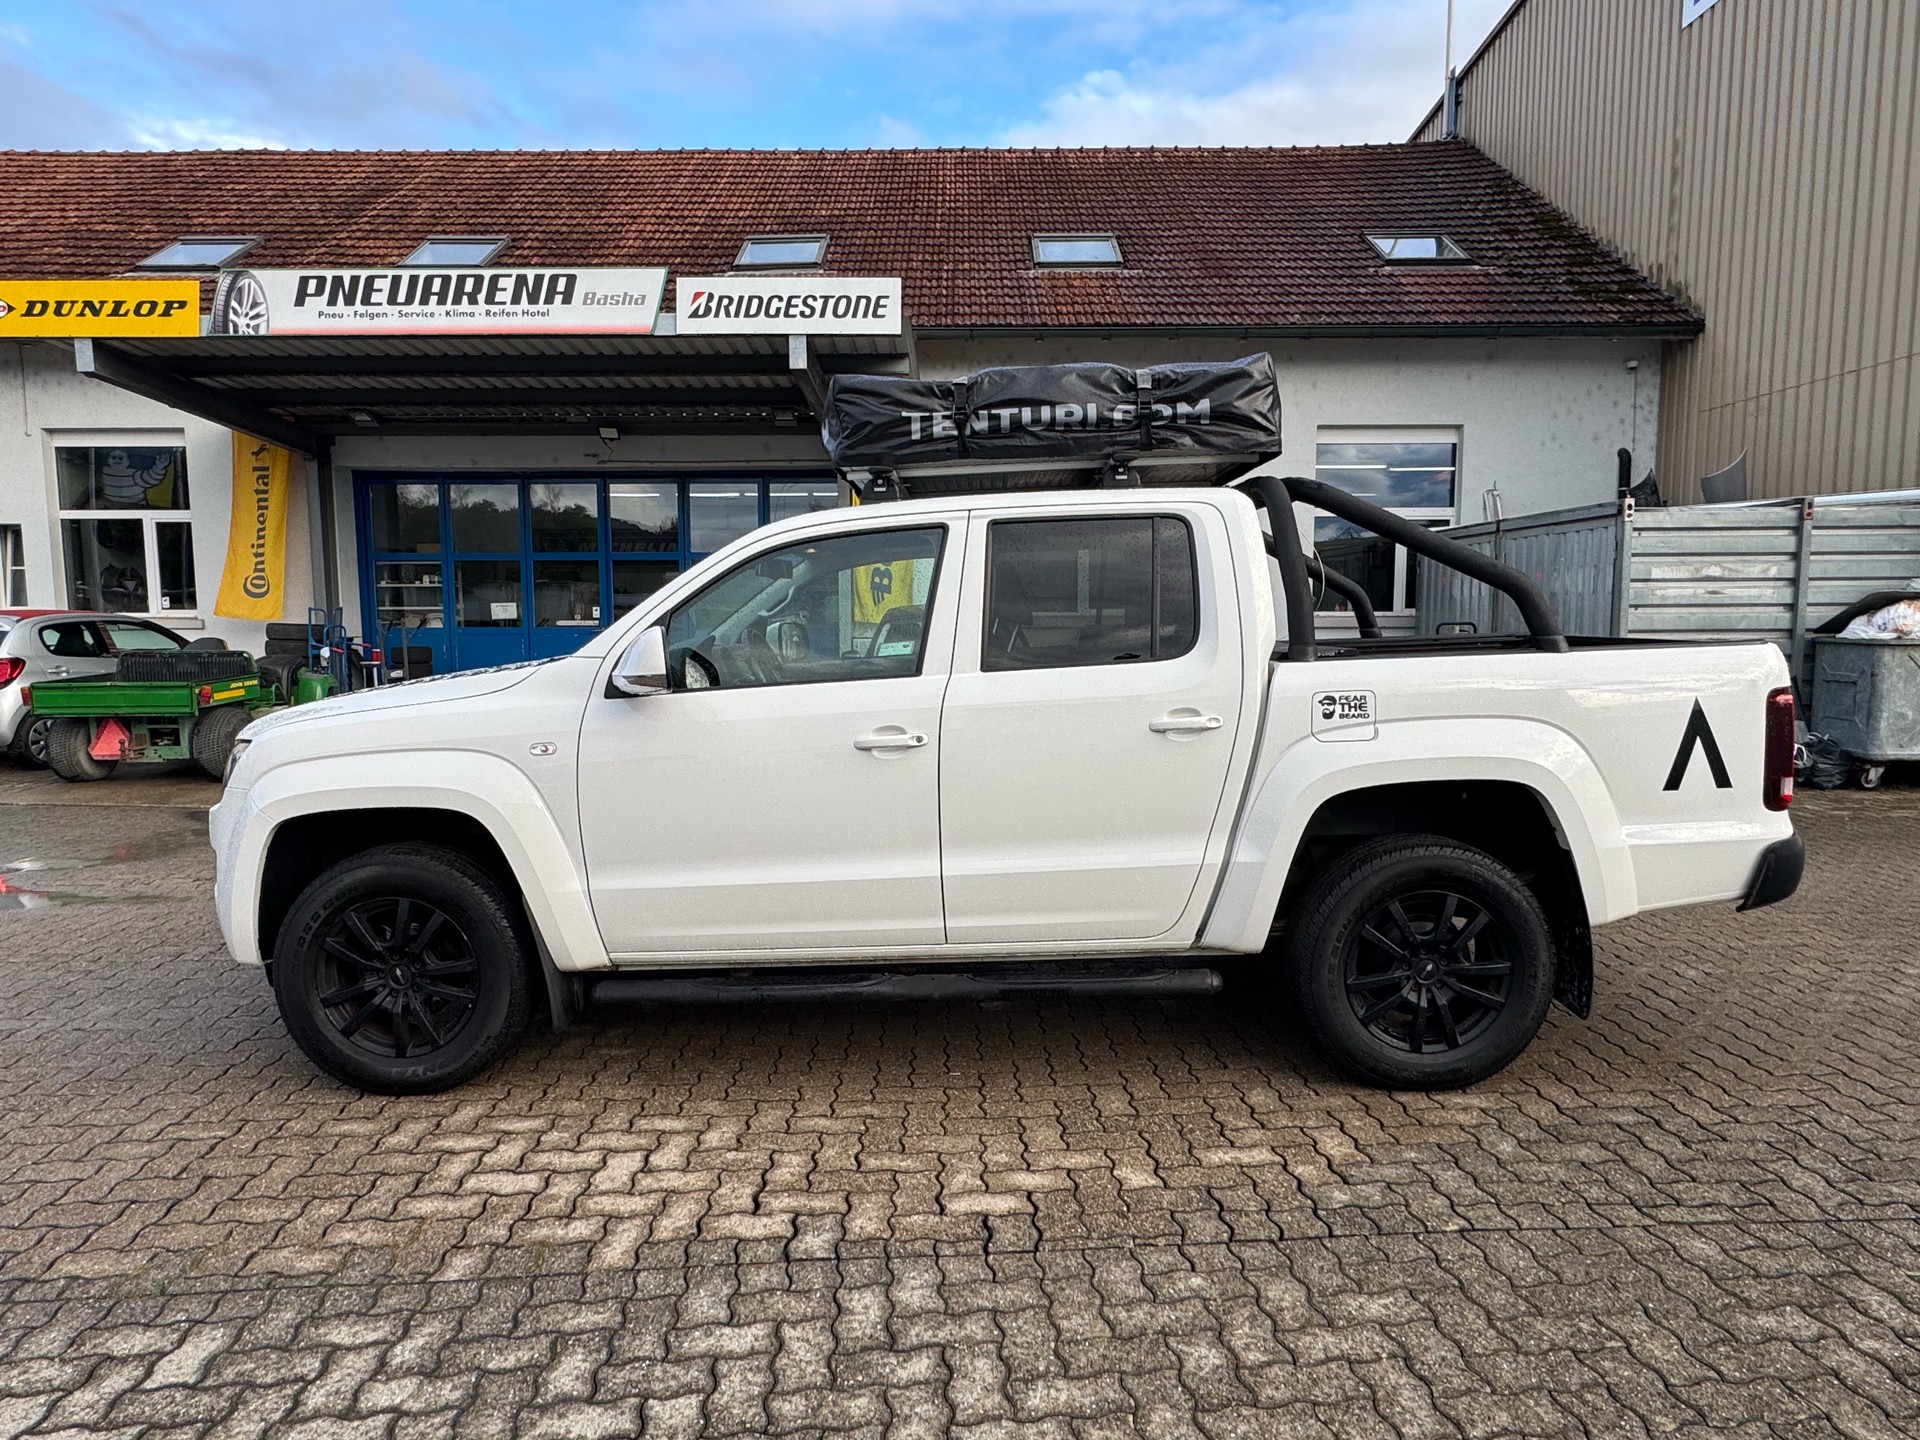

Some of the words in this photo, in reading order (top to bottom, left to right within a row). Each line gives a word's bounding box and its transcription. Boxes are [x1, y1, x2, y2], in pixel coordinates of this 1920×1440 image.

[294, 274, 578, 307] PNEUARENA
[582, 291, 646, 306] Basha
[20, 300, 187, 317] DUNLOP
[318, 310, 344, 319] Pneu
[353, 310, 388, 320] Felgen
[397, 309, 435, 318] Service
[445, 309, 475, 318] Klima
[688, 291, 890, 319] BRIDGESTONE
[243, 465, 271, 598] Continental
[1338, 702, 1368, 712] THE
